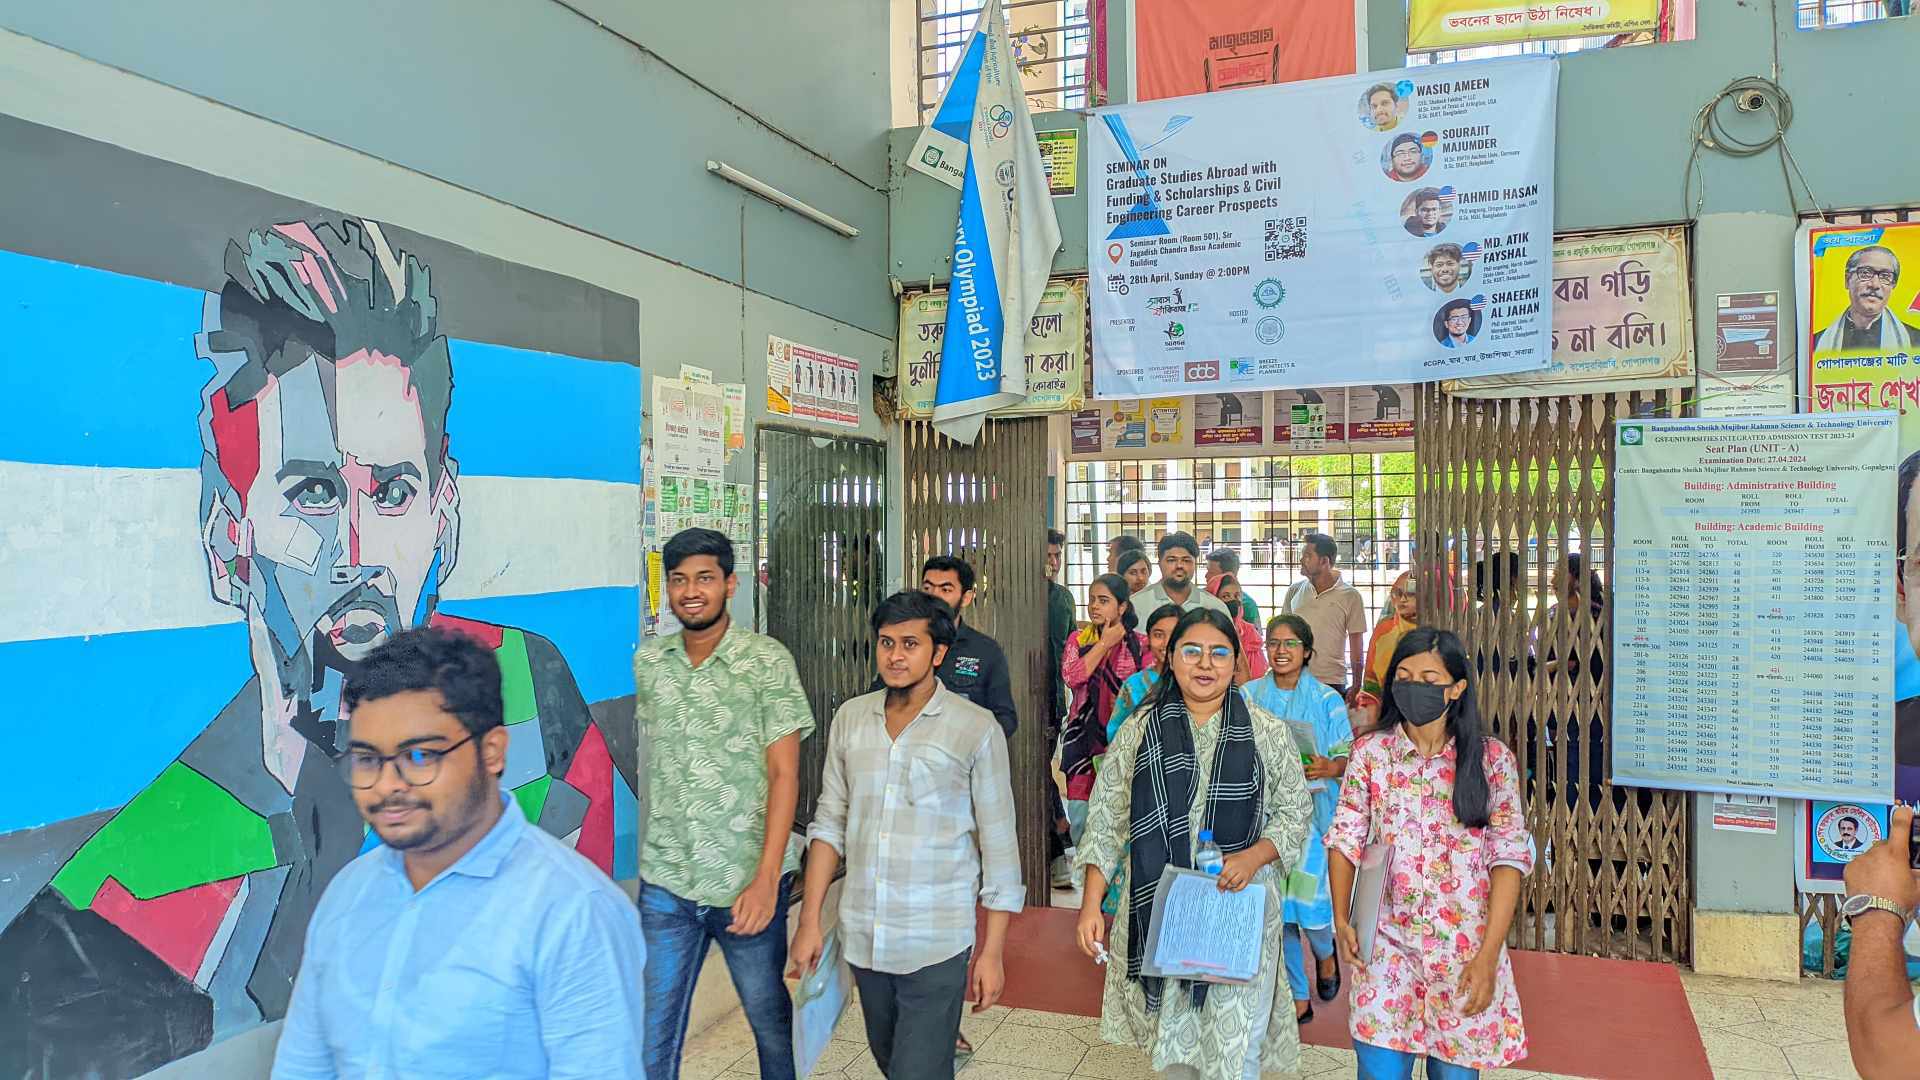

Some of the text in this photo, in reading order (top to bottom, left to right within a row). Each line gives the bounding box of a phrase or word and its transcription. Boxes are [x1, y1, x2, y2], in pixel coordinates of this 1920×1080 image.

[1449, 14, 1490, 28] ভবনের
[1496, 13, 1522, 25] ছাদে
[1528, 8, 1550, 22] উঠা
[1416, 78, 1490, 96] WASIQ AMEEN
[1442, 125, 1490, 140] SOURAJIT
[1442, 138, 1496, 153] MAJUMDER
[1106, 157, 1167, 174] SEMINAR ON
[1106, 160, 1277, 190] Graduate Studies Abroad with
[1106, 177, 1281, 208] Funding & Scholarships & Civil
[1458, 184, 1538, 204] TAHMID HASAN
[1106, 198, 1278, 225] Engineering Career Prospects
[1130, 231, 1233, 248] Seminar Room (Room 501), Sir
[1484, 232, 1529, 250] MD. ATIK
[1130, 240, 1242, 259] Jagadish Chandra Basu Academic
[1484, 246, 1528, 264] FAYSHAL
[1130, 258, 1158, 268] Building
[1130, 266, 1250, 285] 28th April, Sunday @ 2:00PM
[1552, 260, 1650, 302] বন গড়ি
[954, 248, 990, 336] Olympiad
[1492, 288, 1538, 304] SHAEEKH
[1491, 302, 1540, 318] AL JAHAN
[1032, 312, 1063, 338] হলো
[1568, 324, 1596, 352] না
[970, 337, 996, 380] 2023
[1816, 352, 1908, 368] গোপালগঞ্জের মাটি
[1814, 378, 1875, 412] জনাব
[1721, 424, 1748, 432] Mujibur
[1720, 434, 1766, 442] INTEGRATED
[1706, 445, 1724, 454] Seat
[1728, 444, 1747, 453] Plan
[1750, 444, 1780, 454] (UNIT
[1788, 444, 1800, 454] A)
[1704, 466, 1728, 474] Mujibur
[1826, 464, 1859, 472] University,
[1862, 464, 1896, 472] Gopalganj
[1746, 456, 1766, 464] Date:
[1684, 480, 1836, 492] Building: Administrative Building
[1696, 522, 1824, 532] Building: Academic Building
